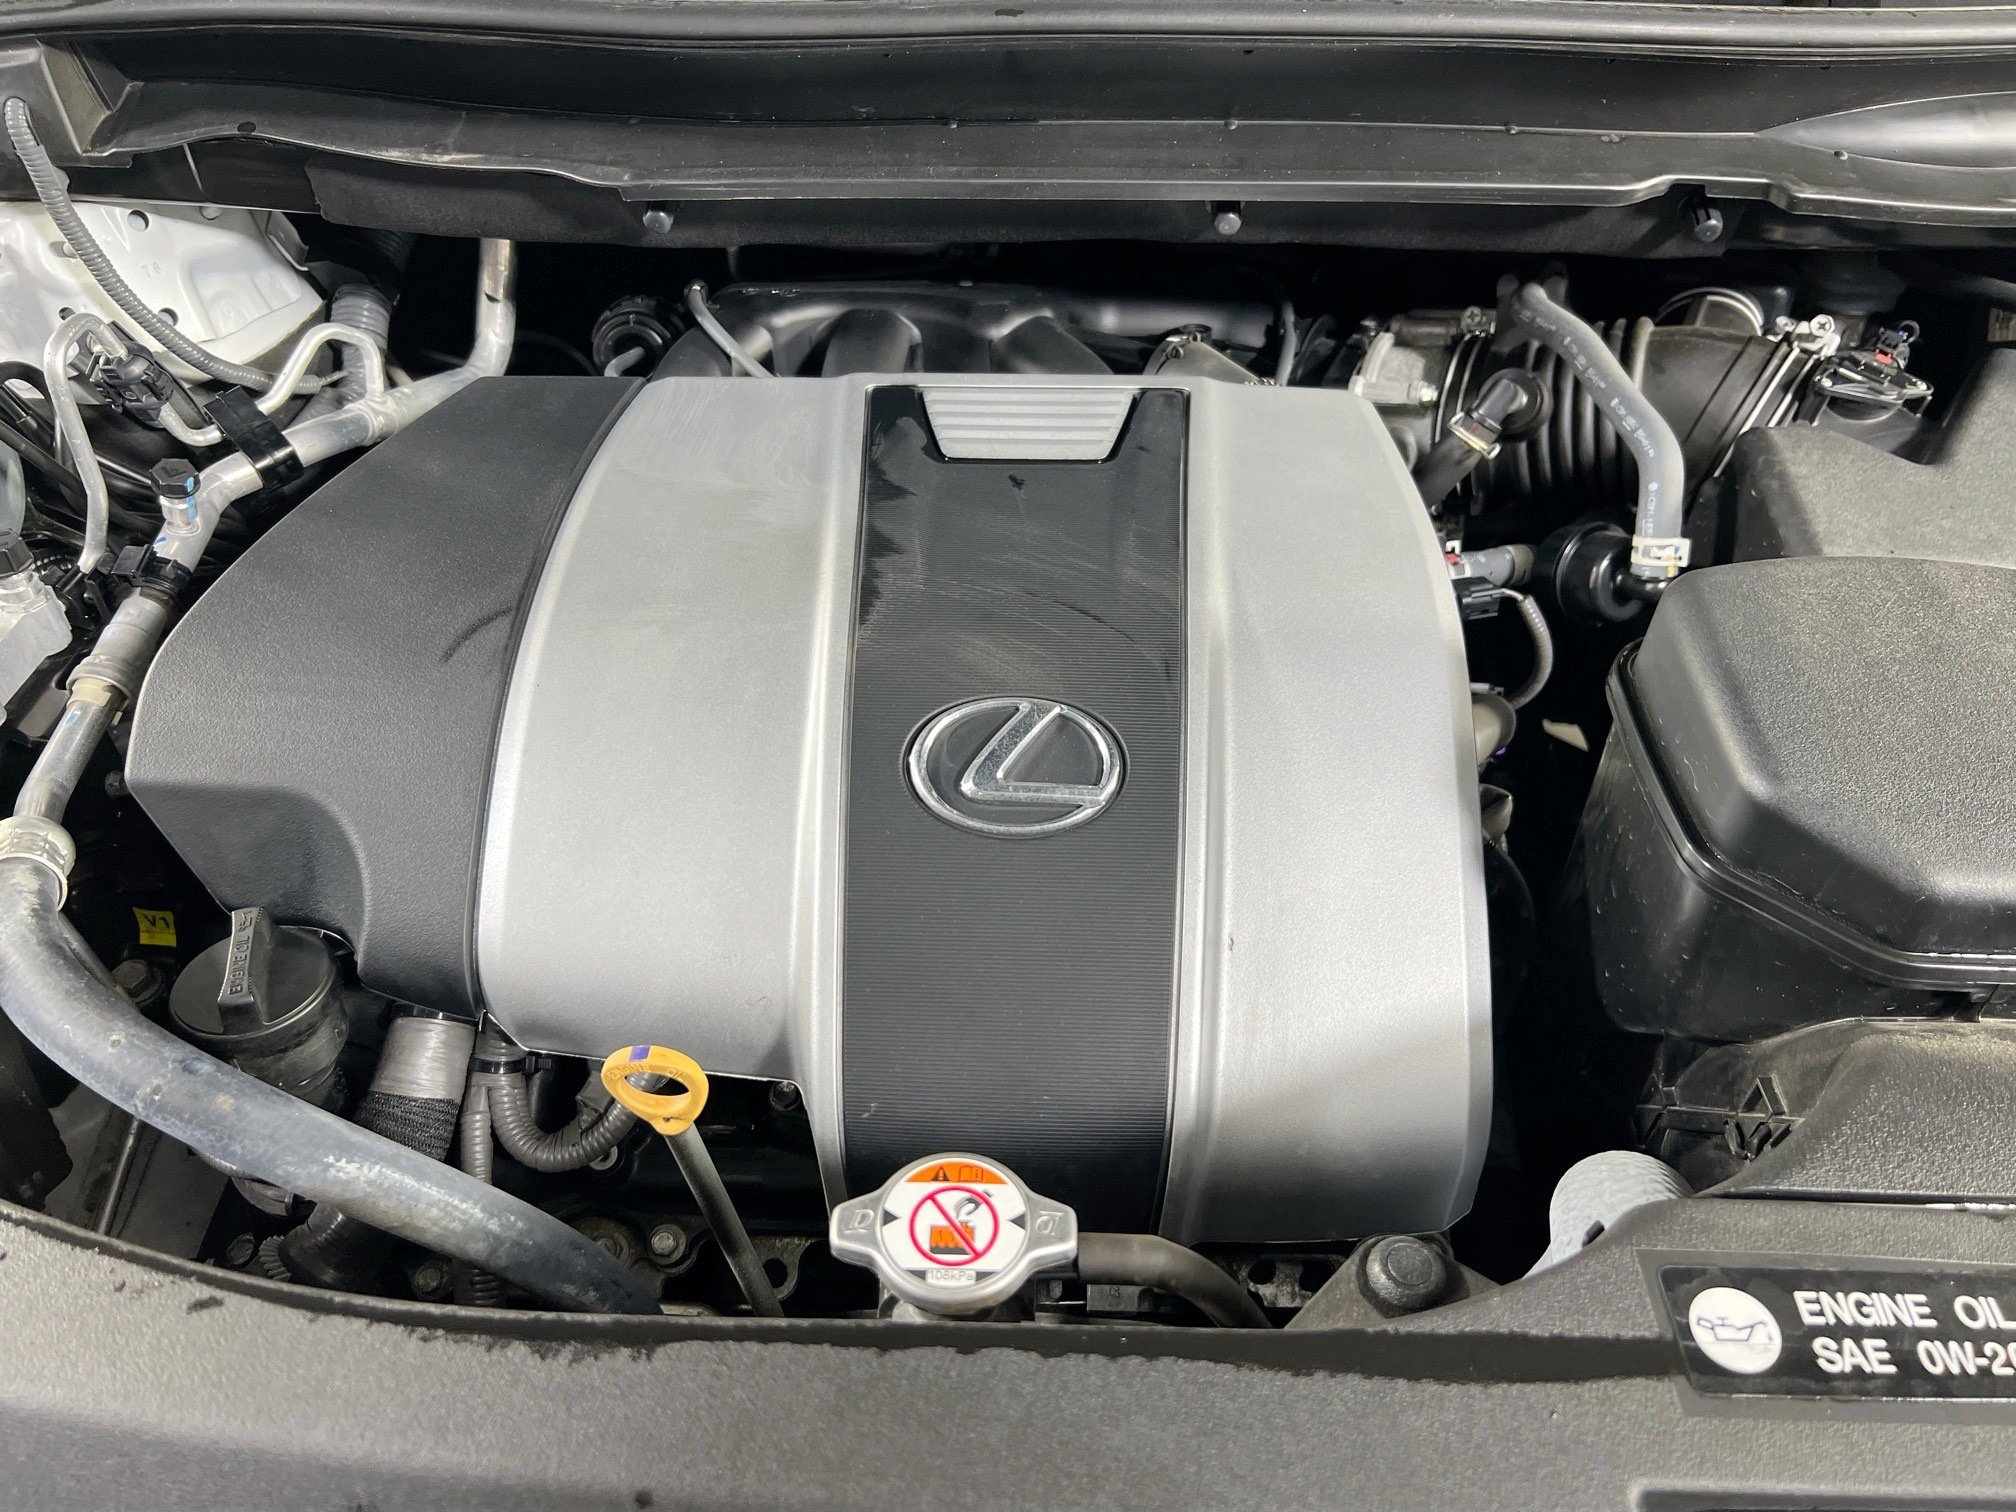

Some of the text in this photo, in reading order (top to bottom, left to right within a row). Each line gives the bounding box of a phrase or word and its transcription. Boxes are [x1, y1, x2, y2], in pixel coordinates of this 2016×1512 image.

[142, 913, 171, 929] V1
[228, 935, 250, 995] ENGINE OIL
[606, 1063, 651, 1080] ENGINE
[929, 1269, 974, 1281] 108kPa
[1793, 1290, 2016, 1330] ENGINE OIL
[1812, 1336, 1898, 1374] SAE
